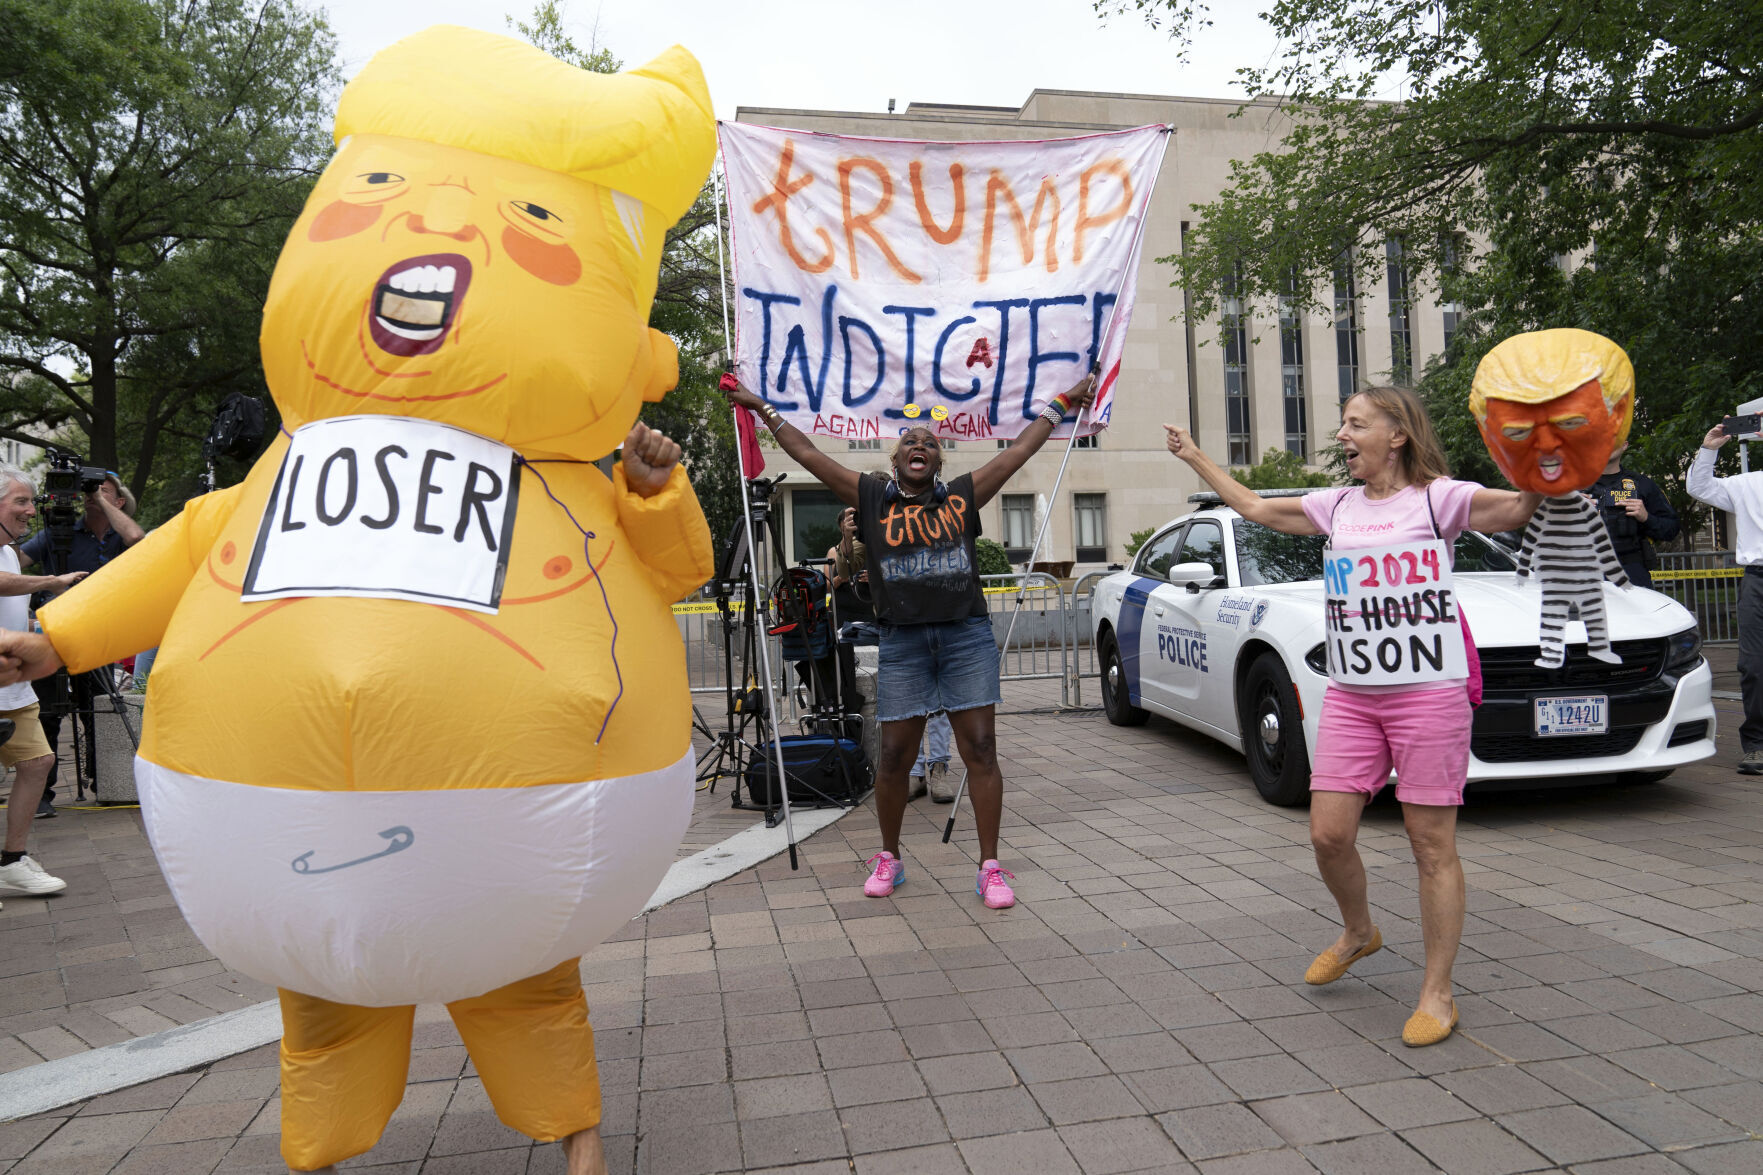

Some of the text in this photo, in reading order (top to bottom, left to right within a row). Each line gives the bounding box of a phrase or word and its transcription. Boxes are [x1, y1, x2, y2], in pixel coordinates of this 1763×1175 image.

[966, 337, 994, 370] A
[813, 406, 993, 438] AGAIN AGAIN
[281, 444, 503, 553] LOSER
[881, 546, 971, 581] INDICTED
[1358, 549, 1440, 588] 2024
[1216, 609, 1242, 630] Security
[1219, 595, 1255, 612] Homeland
[1360, 589, 1456, 632] HOUSE
[1157, 624, 1207, 640] FEDERAL PROTECTIVE SERVICE
[1157, 633, 1209, 673] POLICE
[1558, 704, 1600, 725] 1242U
